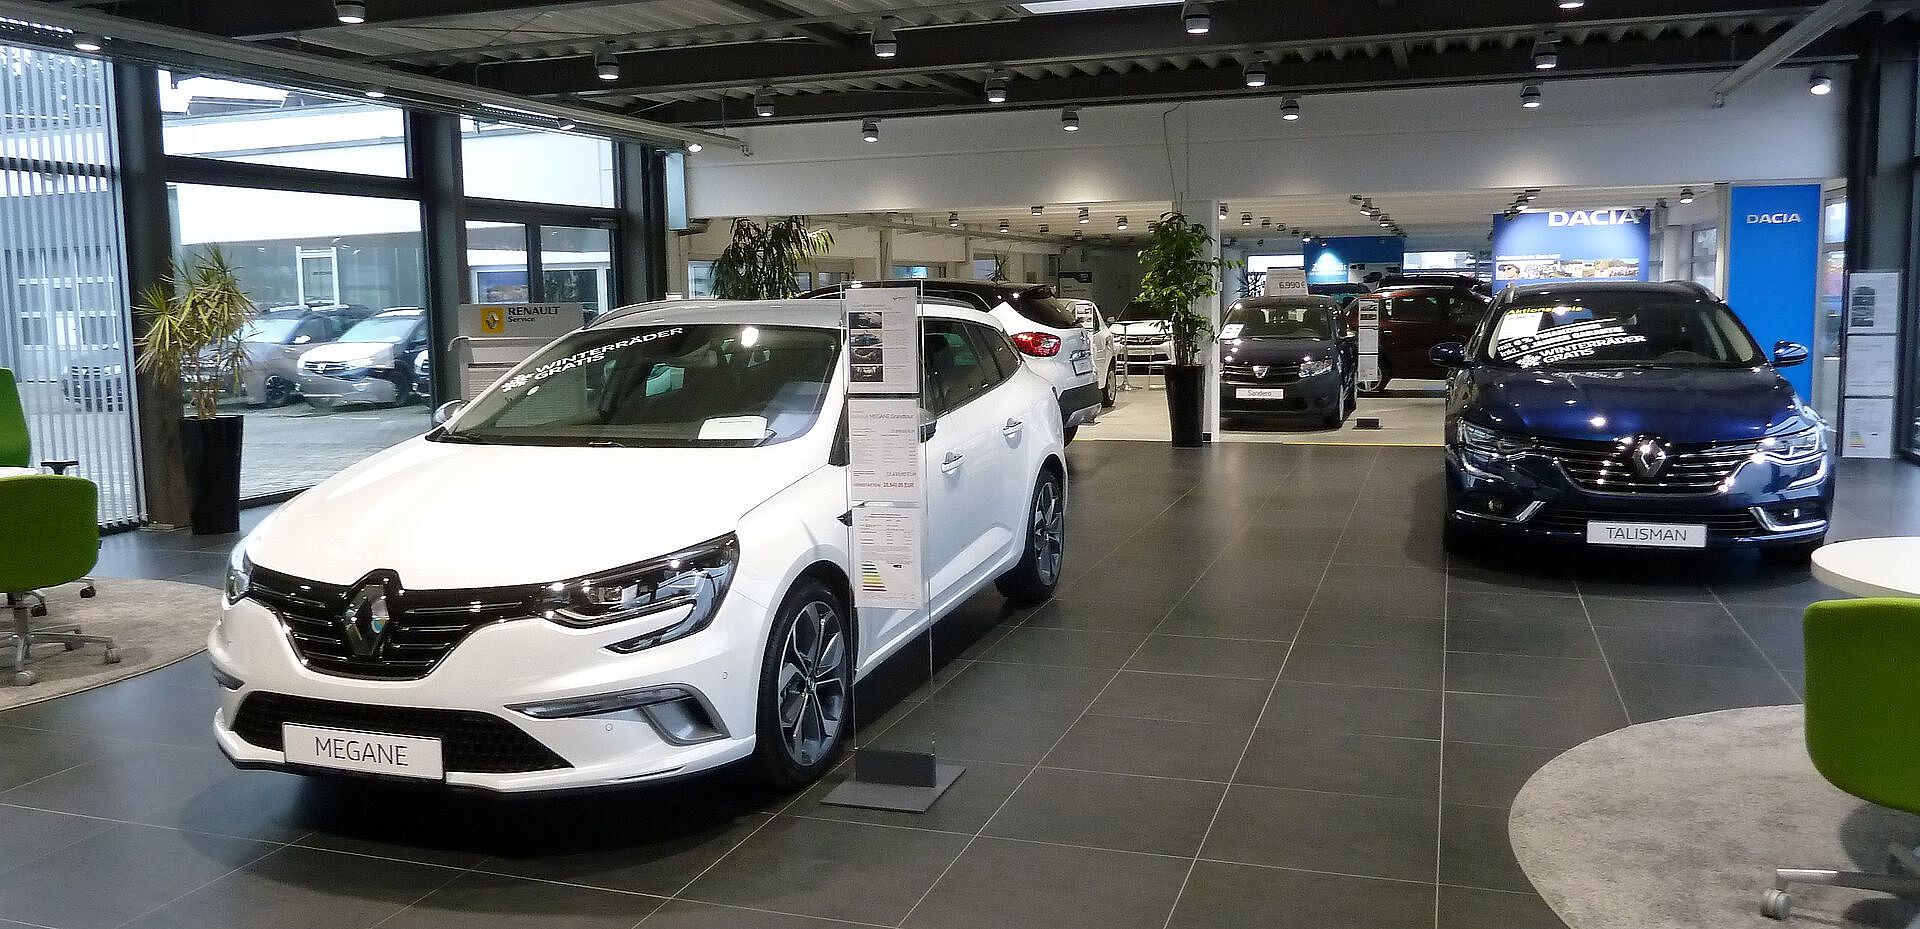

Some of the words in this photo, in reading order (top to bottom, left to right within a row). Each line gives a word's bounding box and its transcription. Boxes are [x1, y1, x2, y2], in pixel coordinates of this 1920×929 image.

[1548, 210, 1641, 227] DACIA
[1746, 213, 1802, 224] DACIA
[508, 306, 560, 316] RENAULT
[1507, 305, 1583, 316] Aktionspeis
[535, 327, 683, 373] WINTERRÄDER
[1539, 335, 1648, 357] WINTERRÄDER
[1543, 349, 1595, 364] GRATIS
[534, 352, 605, 380] GRATIS
[1247, 389, 1272, 397] Sandero
[1605, 527, 1687, 541] TALISMAN
[314, 736, 409, 766] MEGANE
